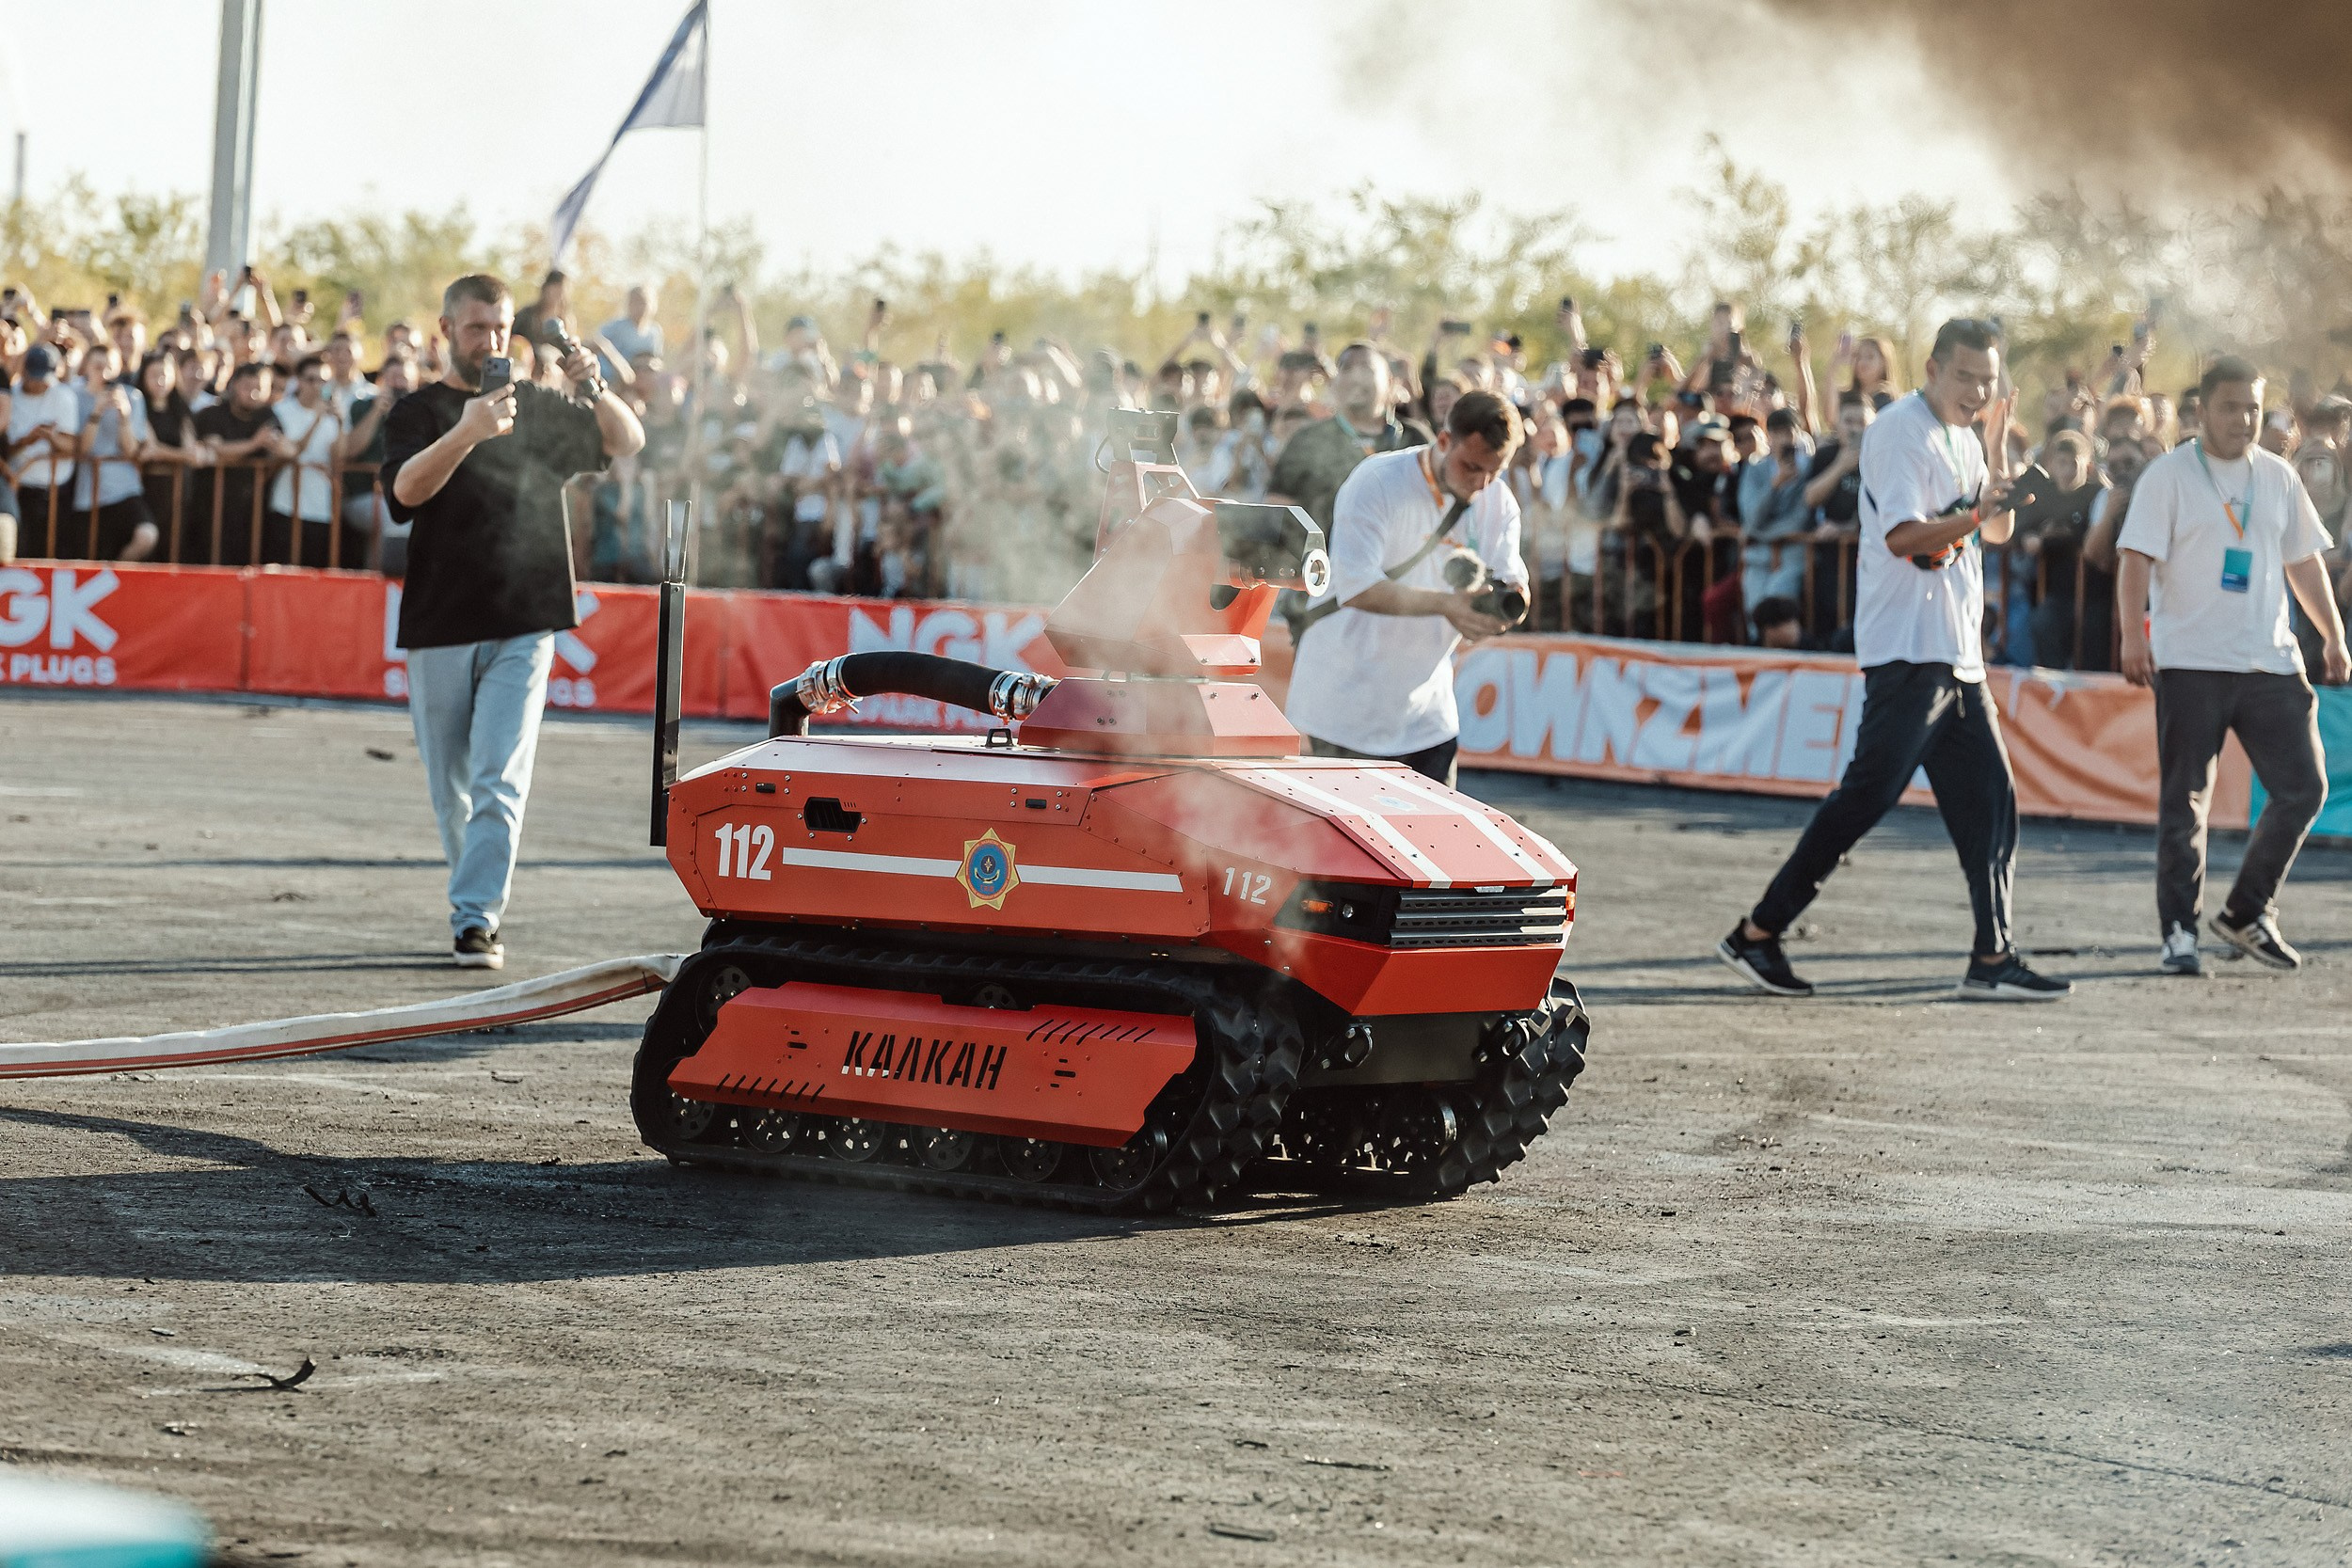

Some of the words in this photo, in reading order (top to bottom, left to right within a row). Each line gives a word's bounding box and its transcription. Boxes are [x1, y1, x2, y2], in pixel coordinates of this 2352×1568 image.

[9, 653, 118, 685] PLUGS
[715, 822, 774, 880] 112
[1223, 866, 1271, 905] 112
[841, 1031, 1008, 1090] КАЛКАН
